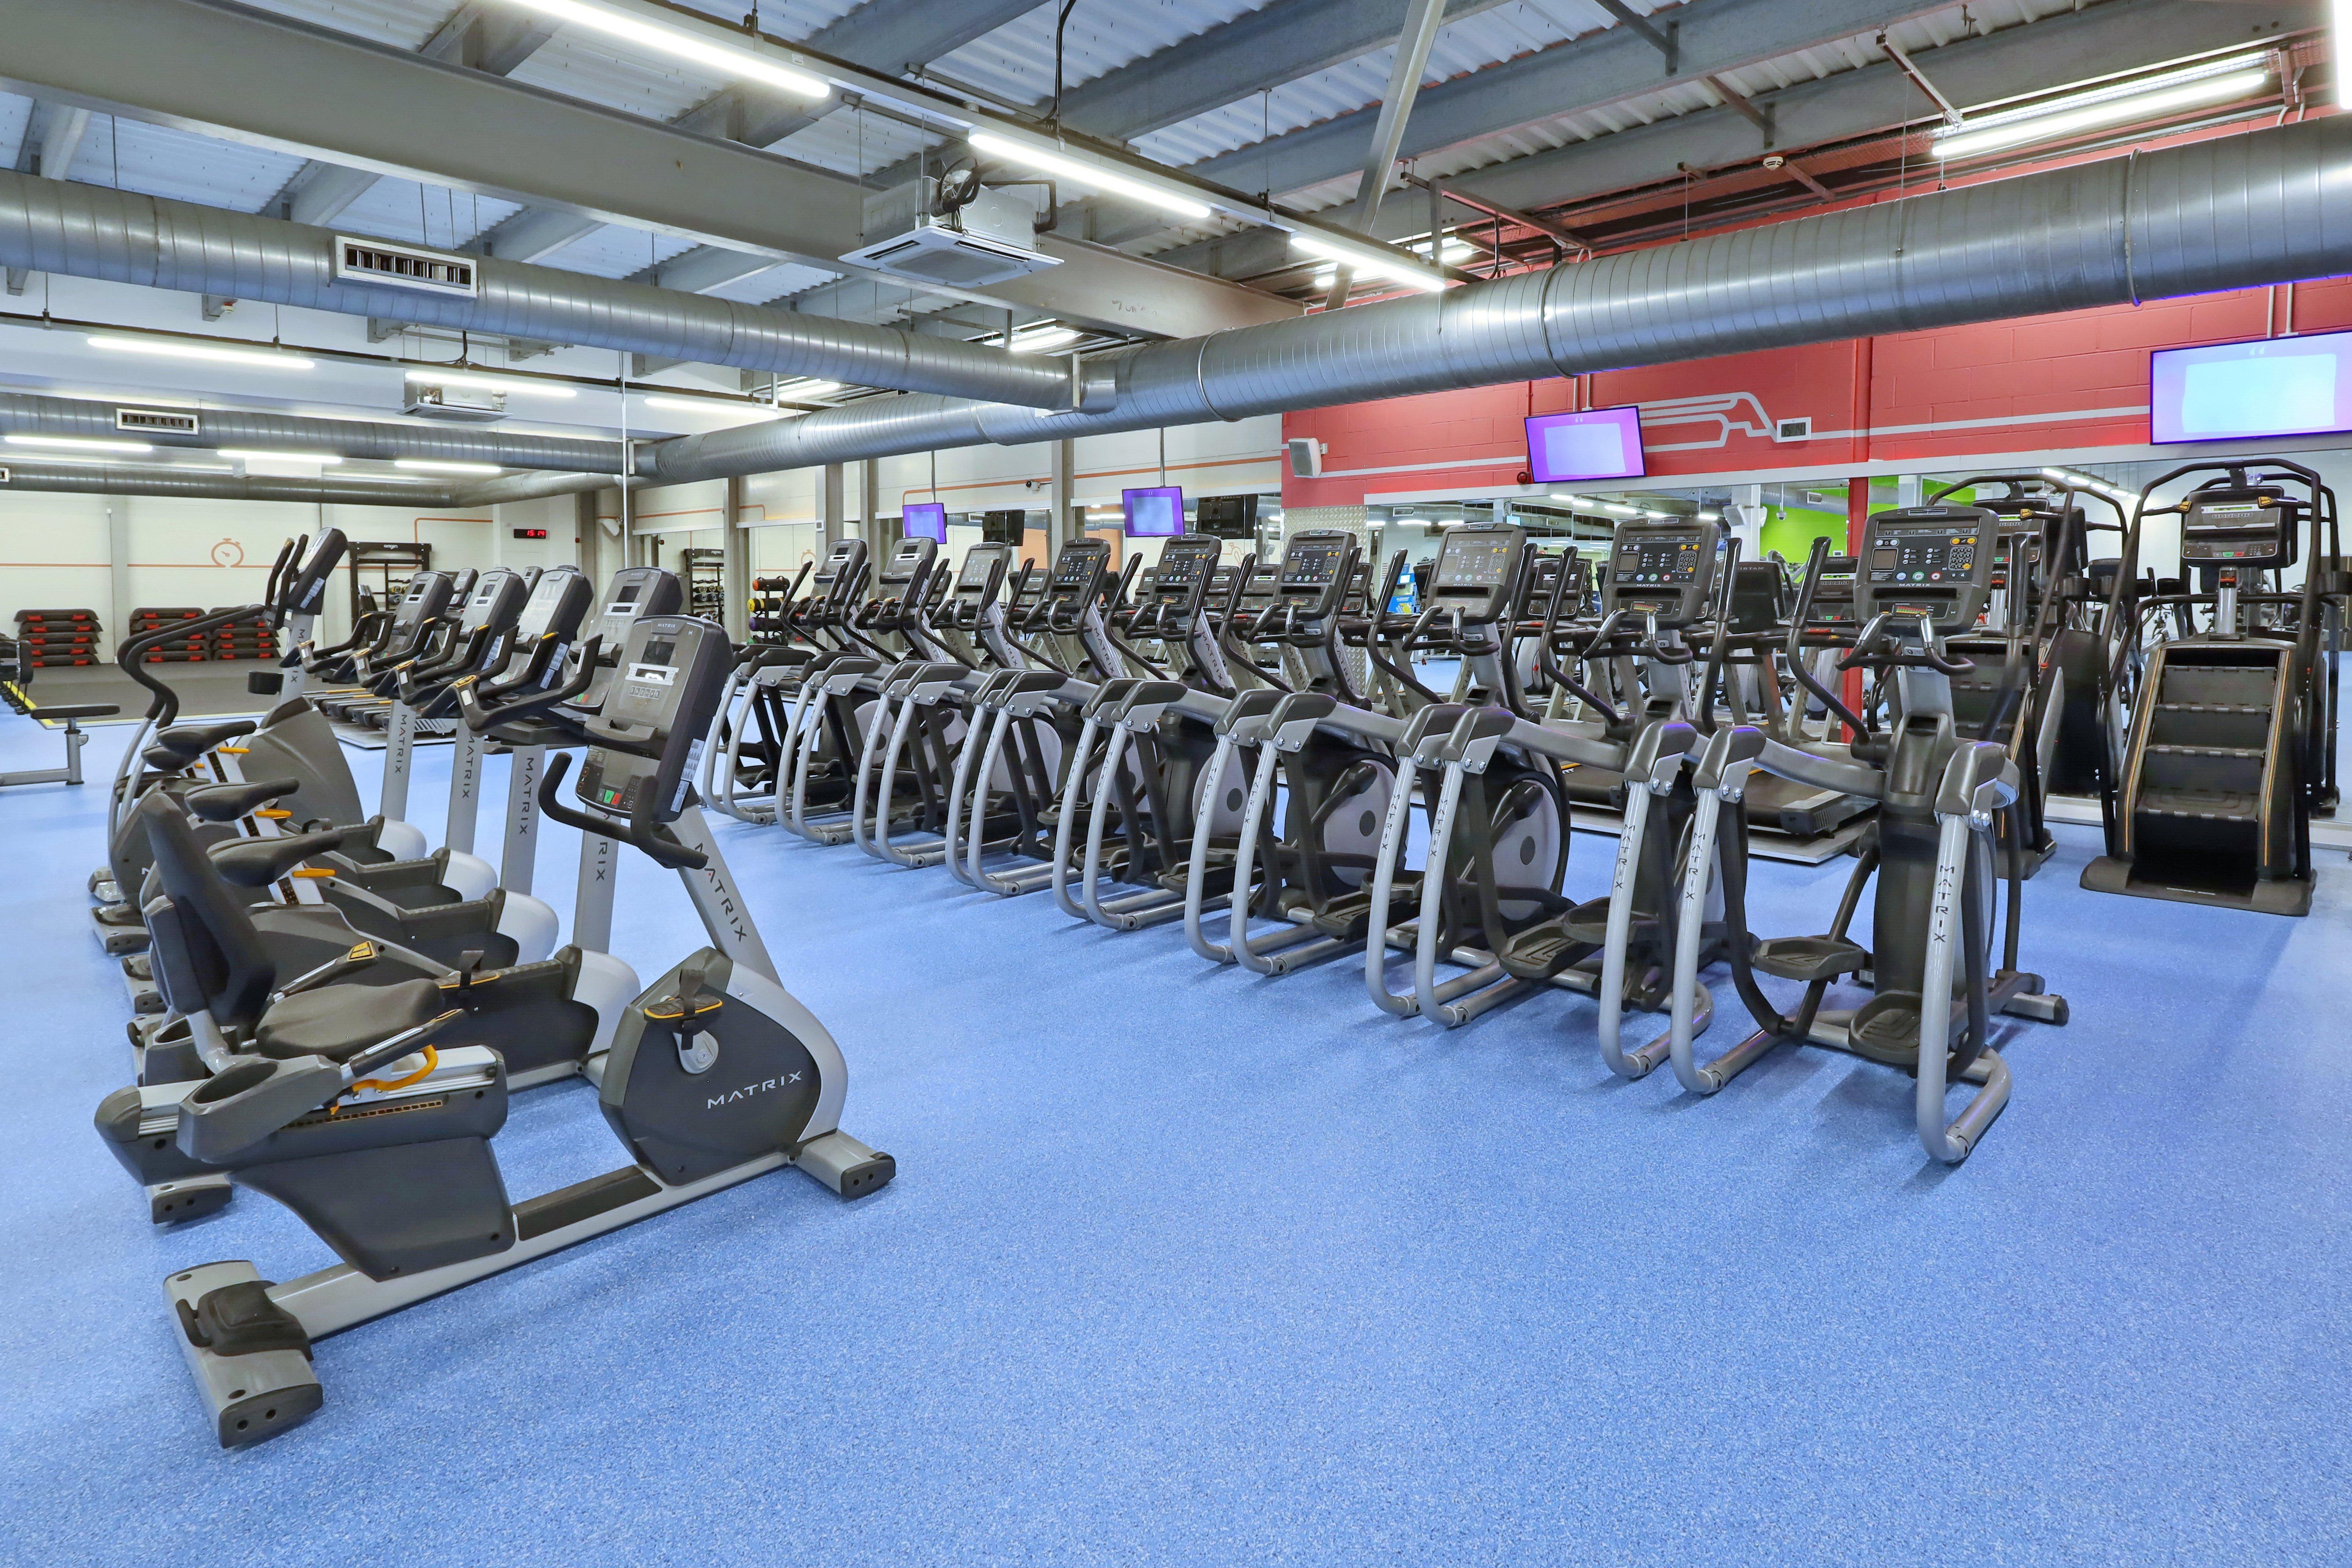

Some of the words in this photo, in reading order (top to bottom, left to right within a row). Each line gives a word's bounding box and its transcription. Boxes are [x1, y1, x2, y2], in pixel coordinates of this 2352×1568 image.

[947, 629, 961, 653] MATR
[1094, 628, 1114, 673] MATRIX
[1203, 632, 1223, 681] MATRIX
[395, 714, 407, 774] MATRIX
[462, 736, 475, 799] MATRIX
[519, 757, 534, 835] MATRIX
[1382, 794, 1400, 850] MATRIX
[1430, 799, 1448, 857] MATRIX
[1615, 824, 1635, 889] MATRIX
[694, 842, 747, 942] MATRIX
[1685, 833, 1706, 900] MATRIX
[1933, 865, 1955, 942] MATRIX
[707, 1070, 802, 1109] MATRIX
